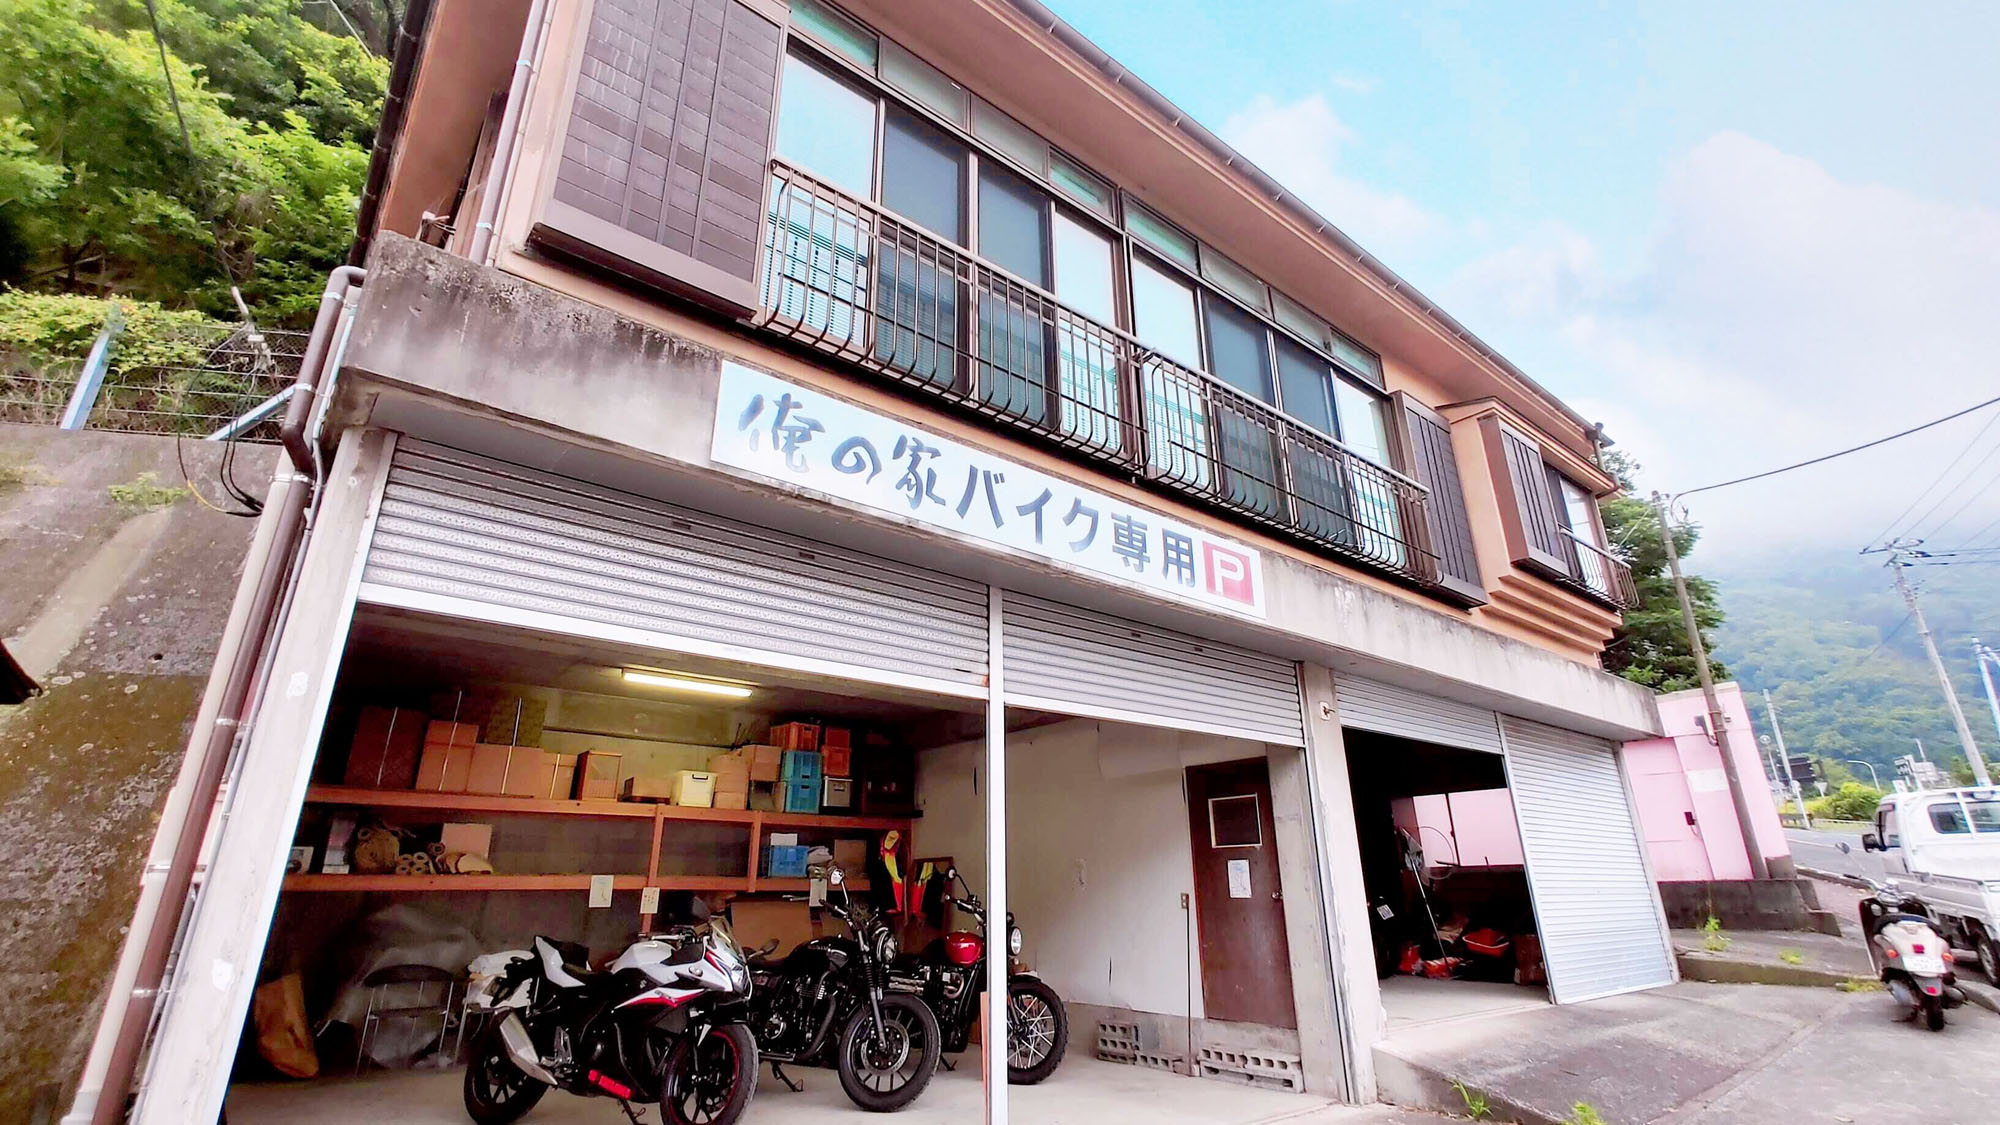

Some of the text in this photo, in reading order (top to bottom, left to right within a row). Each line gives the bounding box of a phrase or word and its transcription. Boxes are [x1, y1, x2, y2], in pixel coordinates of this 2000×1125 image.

[738, 393, 1195, 588] 俺の家バイク専用
